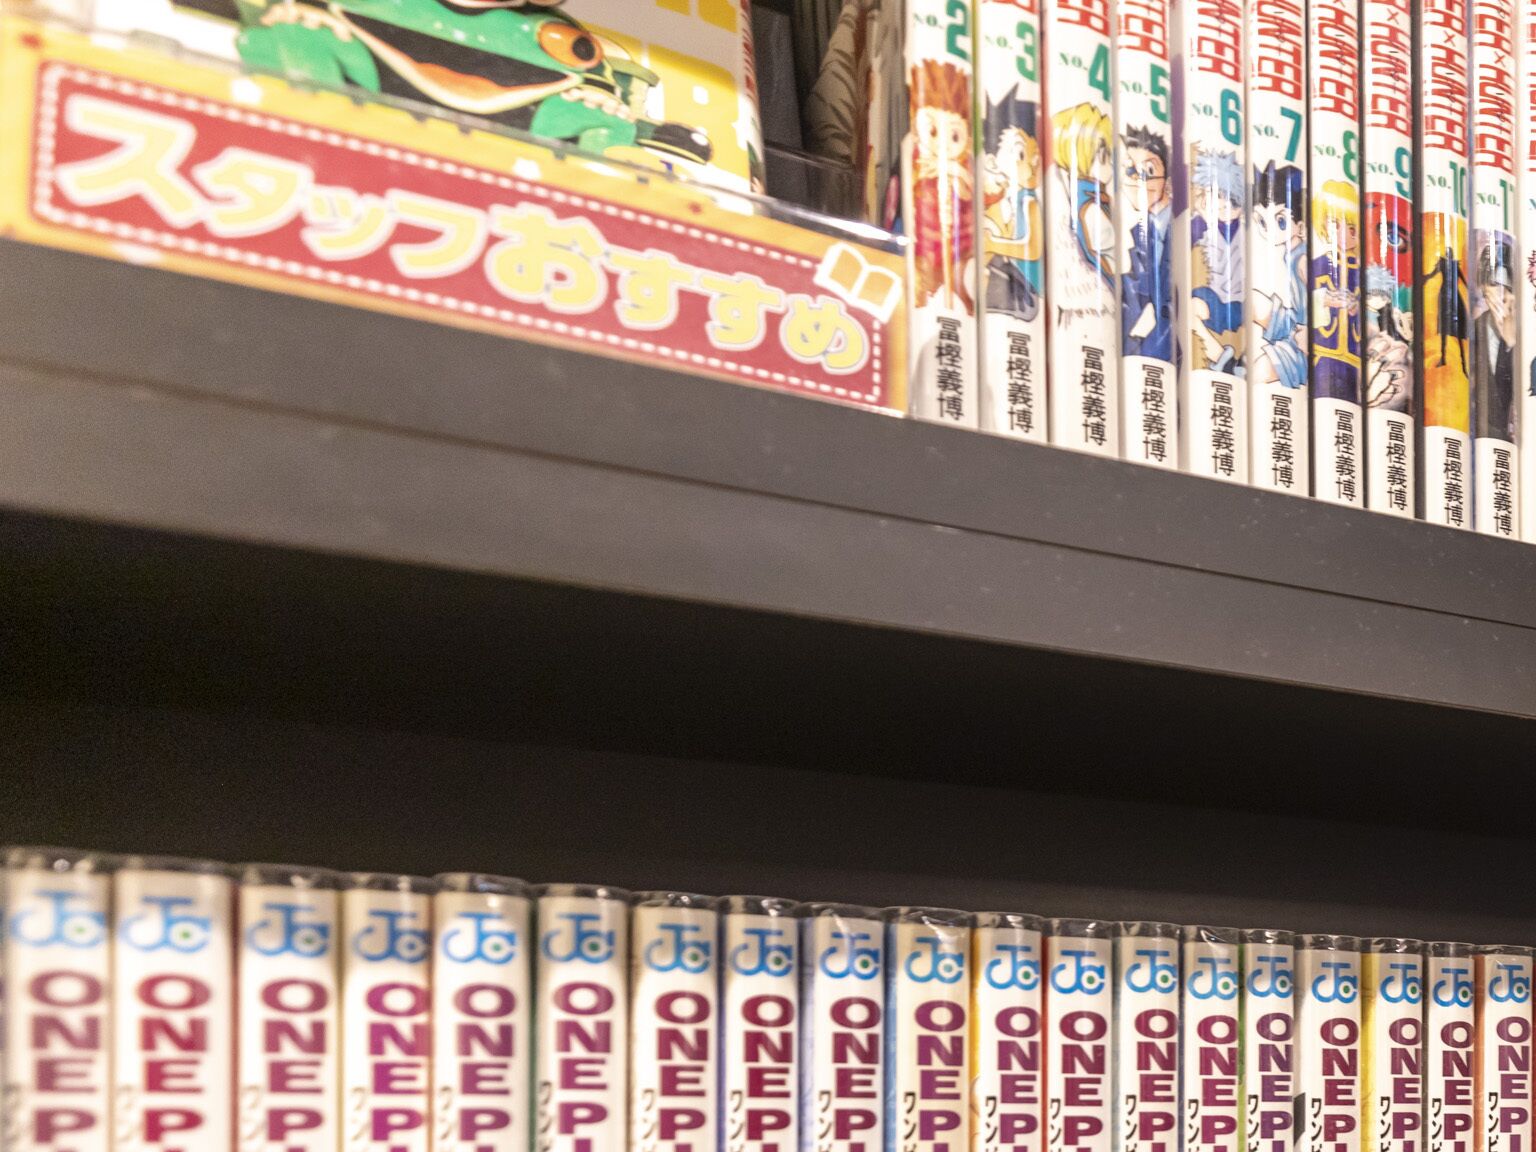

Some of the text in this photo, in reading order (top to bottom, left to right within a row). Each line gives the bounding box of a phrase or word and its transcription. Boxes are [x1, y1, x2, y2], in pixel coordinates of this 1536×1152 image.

[58, 88, 870, 375] スタッフおすすめ
[27, 969, 105, 1094] ONE
[136, 973, 211, 1094] ONE
[260, 978, 329, 1094] ONE
[453, 983, 517, 1095] ONE
[552, 982, 614, 1091] ONE
[654, 991, 711, 1097] ONE
[741, 994, 794, 1098] ONE
[829, 997, 881, 1099] ONE
[914, 1001, 966, 1100] ONE
[995, 1006, 1041, 1105] ONE
[1059, 1010, 1107, 1107] ONE
[1196, 1015, 1238, 1107] ONE
[1256, 1012, 1294, 1103] ONE
[1319, 1017, 1359, 1107] ONE
[1388, 1018, 1422, 1104] ONE
[1440, 1021, 1473, 1106] ONE
[1496, 1016, 1530, 1100] ONE
